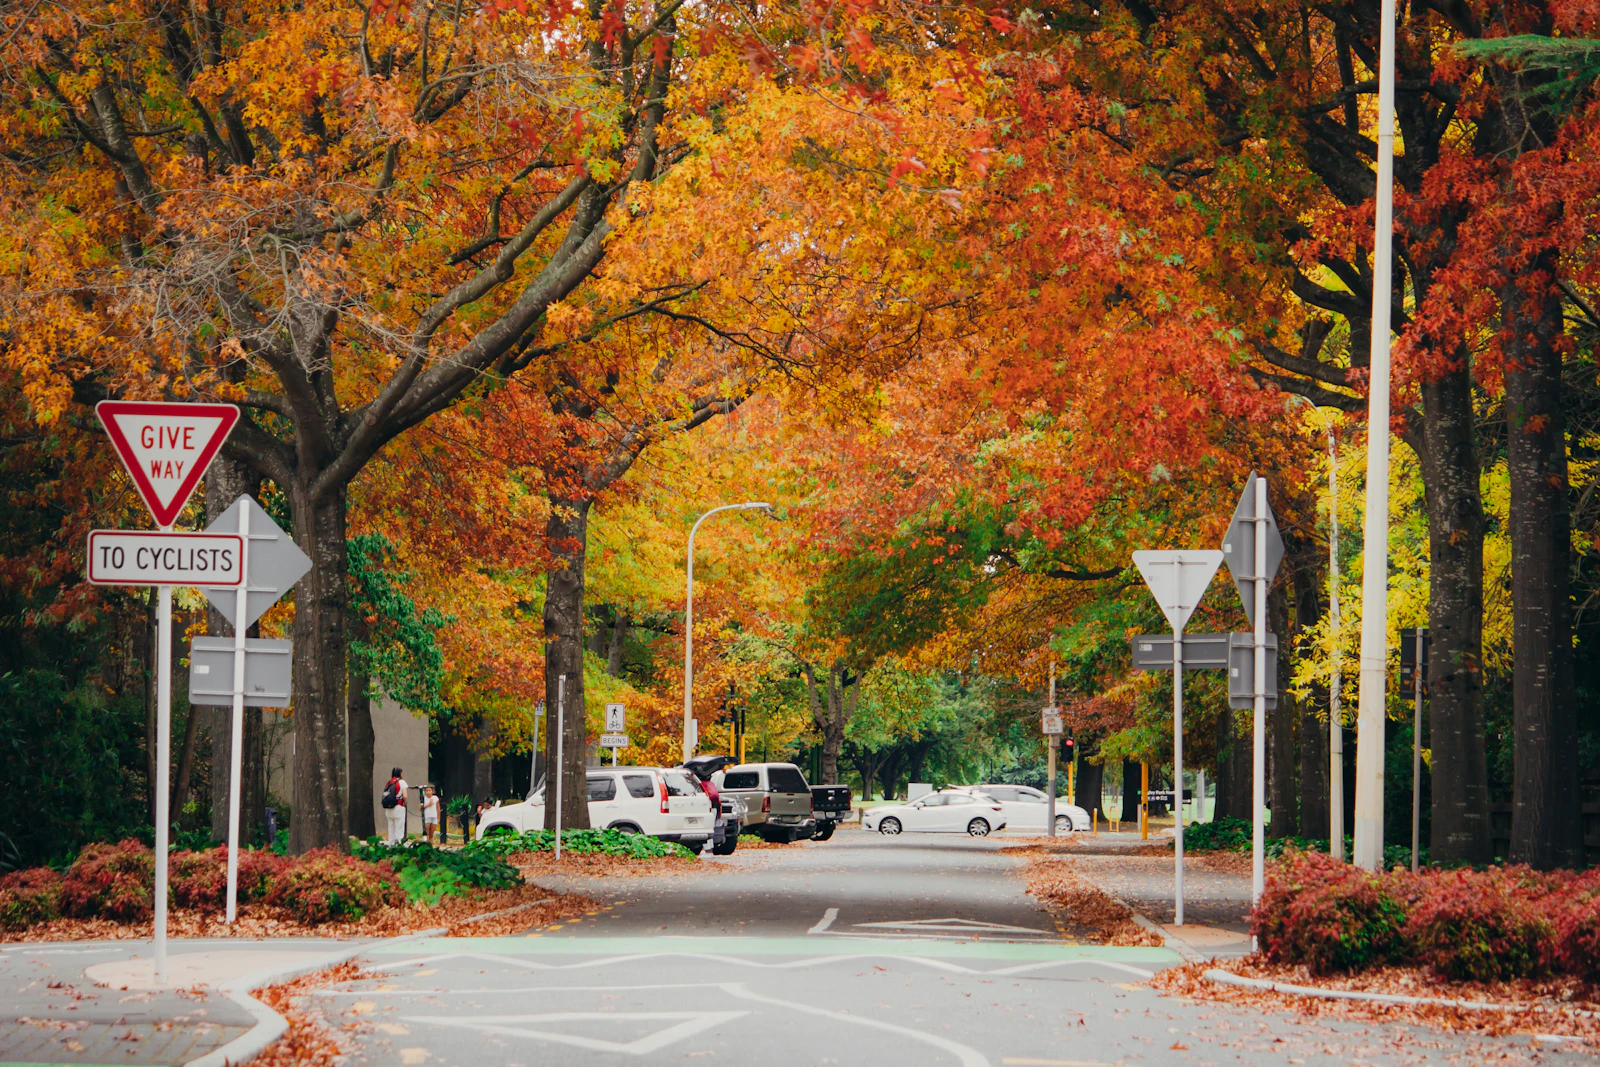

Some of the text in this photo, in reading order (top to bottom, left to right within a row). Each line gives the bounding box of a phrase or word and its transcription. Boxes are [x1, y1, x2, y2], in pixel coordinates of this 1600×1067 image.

[140, 425, 196, 450] GIVE
[150, 459, 185, 480] WAY
[100, 546, 233, 572] TO CYCLISTS
